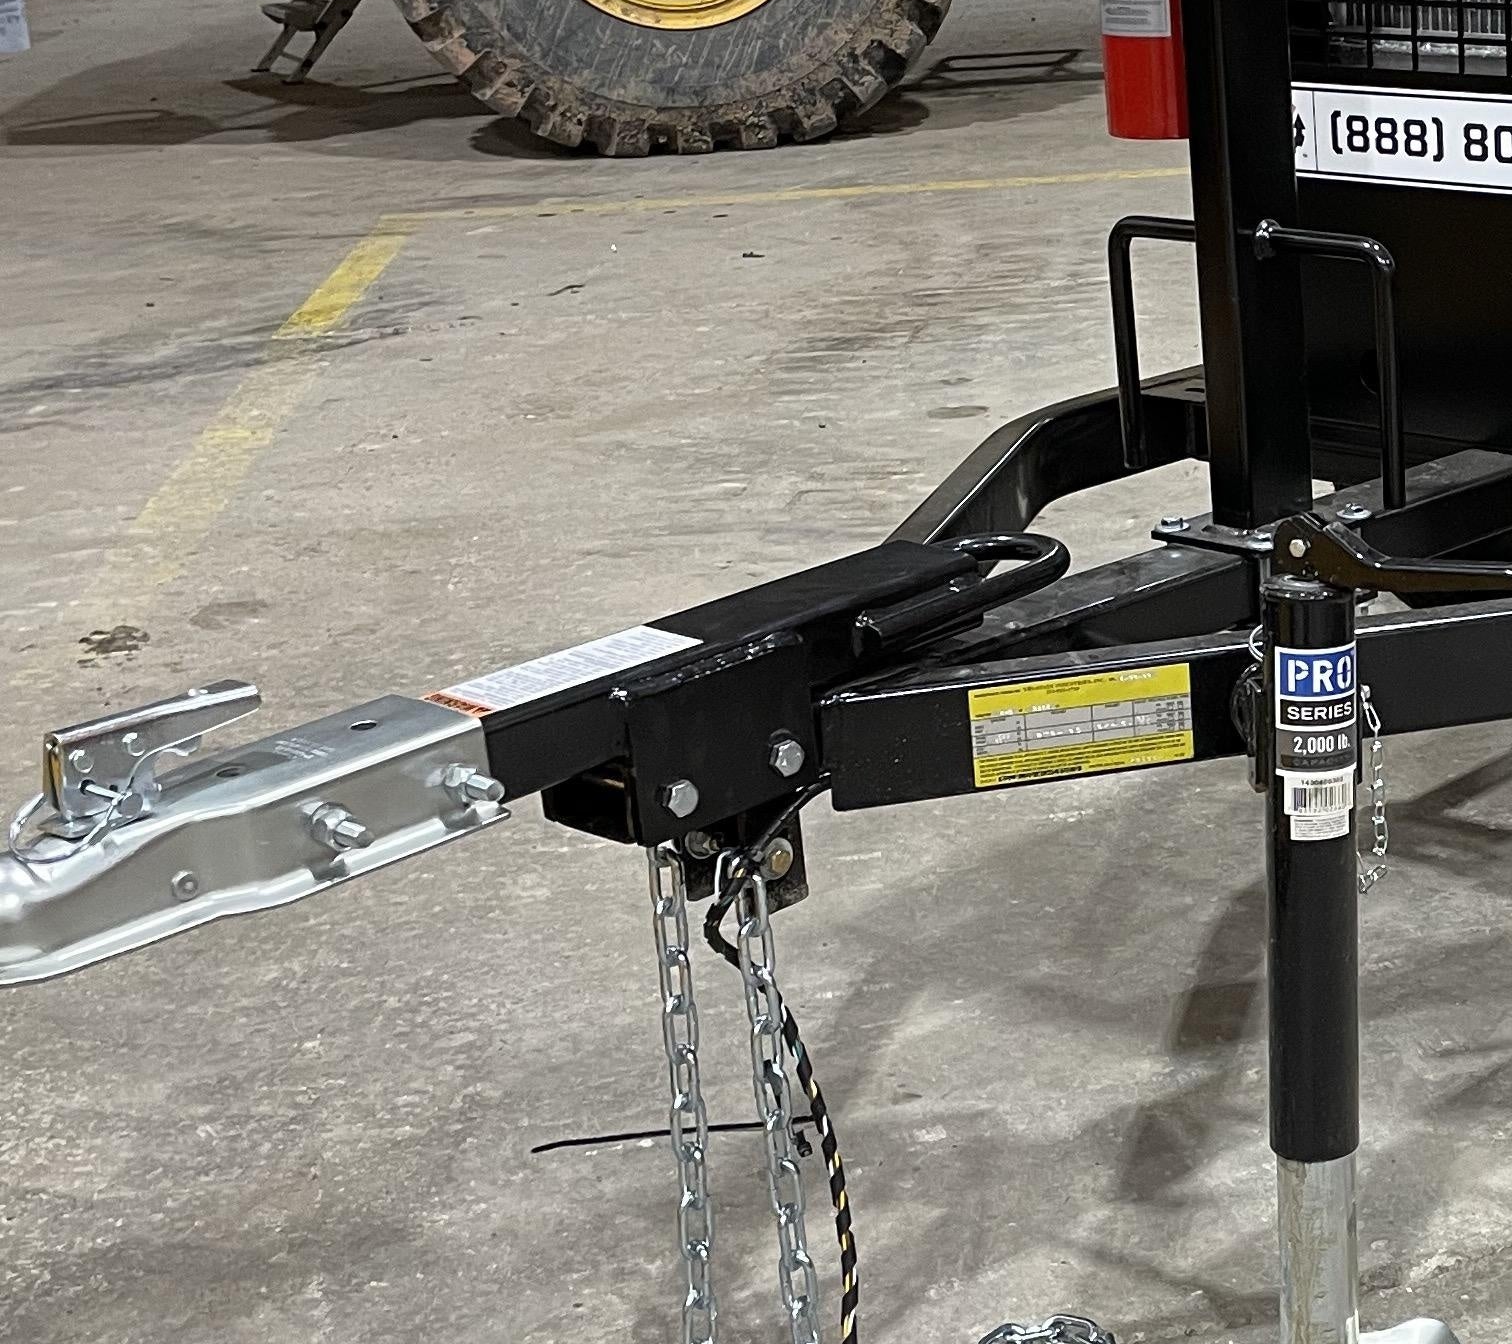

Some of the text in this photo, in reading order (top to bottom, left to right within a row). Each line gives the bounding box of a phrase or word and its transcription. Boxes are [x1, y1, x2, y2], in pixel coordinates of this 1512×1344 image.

[1330, 110, 1444, 163] (888)
[1288, 655, 1351, 693] PRO
[1287, 701, 1352, 721] SERIES
[1293, 733, 1351, 756] 2,000 lb.
